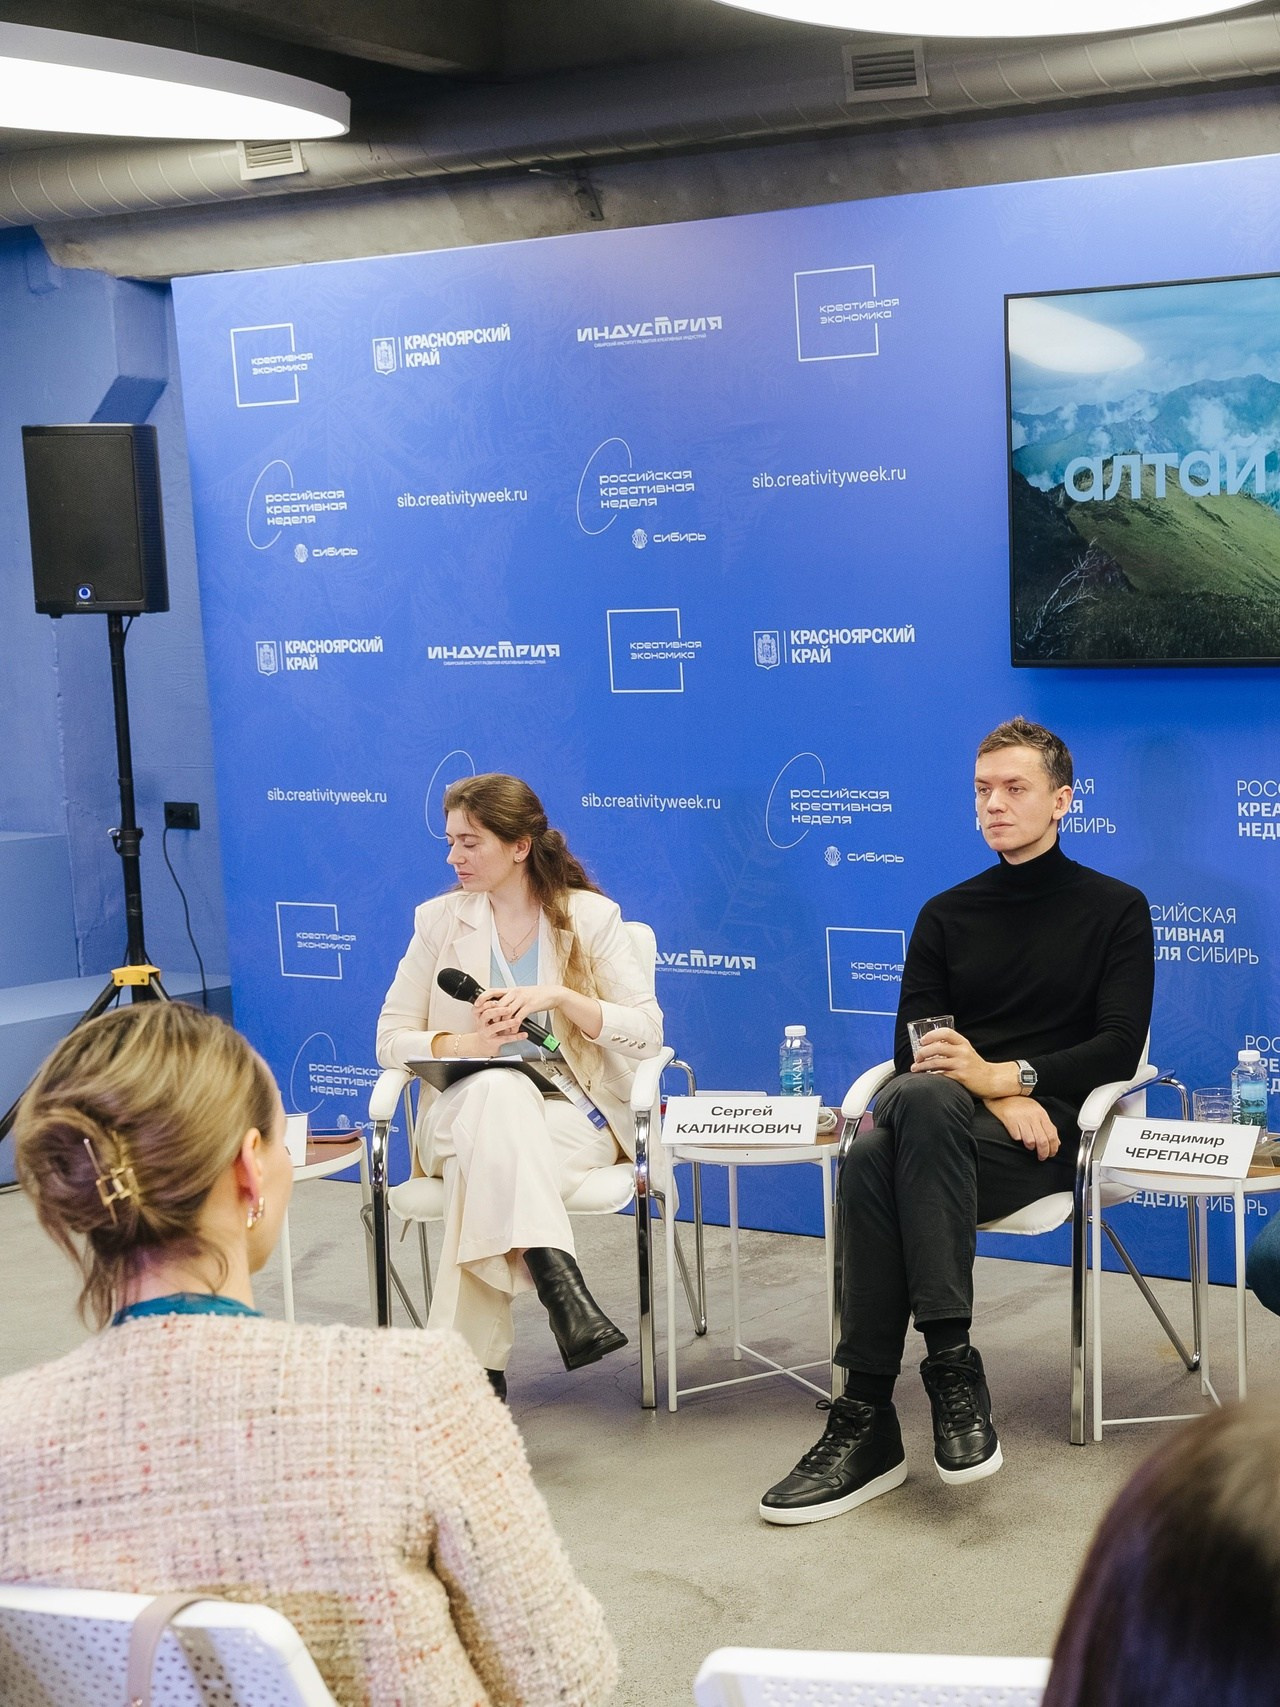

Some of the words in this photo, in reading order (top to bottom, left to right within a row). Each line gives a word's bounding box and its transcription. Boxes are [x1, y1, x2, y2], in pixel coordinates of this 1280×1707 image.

[819, 298, 899, 314] креативная
[820, 309, 892, 325] экономика
[404, 323, 511, 350] КРАСНОЯРСКИЙ
[576, 315, 723, 342] ИНДУСТРИЯ
[251, 352, 313, 365] креативная
[405, 349, 441, 368] КРАЙ
[251, 362, 308, 376] экономика
[1064, 434, 1267, 502] алтай
[599, 470, 692, 485] российская
[752, 465, 907, 490] sib.creativityweek.ru
[265, 489, 345, 503] российская
[600, 482, 695, 498] креативная
[397, 487, 528, 510] sib.creativityweek.ru
[600, 496, 658, 510] неделя
[266, 501, 347, 516] креативная
[267, 513, 316, 527] неделя
[652, 530, 707, 544] сибирь
[312, 546, 358, 559] сибирь
[790, 624, 915, 645] КРАСНОЯРСКИЙ
[284, 635, 383, 655] КРАСНОЯРСКИЙ
[427, 640, 561, 659] ИНДУСТРИЯ
[629, 640, 702, 651] креативная
[286, 653, 319, 671] КРАЙ
[630, 650, 696, 661] экономика
[791, 645, 832, 664] КРАЙ
[267, 787, 387, 806] sib.creativityweek.ru
[790, 786, 890, 800] российская
[581, 792, 721, 812] sib.creativityweek.ru
[791, 800, 892, 813] креативная
[791, 813, 852, 826] неделя
[1060, 816, 1117, 834] ИБИРЬ
[847, 851, 905, 864] сибирь
[1149, 902, 1237, 924] СИЙСКАЯ
[296, 930, 356, 942] креативная
[1153, 926, 1225, 943] ТИВНАЯ
[297, 940, 351, 952] экономика
[655, 949, 756, 970] ДУСТРИЯ
[1186, 945, 1260, 965] СИБИРЬ
[851, 961, 905, 972] креатив
[851, 972, 903, 982] эконом
[310, 1085, 358, 1097] неделя
[710, 1104, 773, 1119] Сергей
[675, 1122, 802, 1135] КАЛИНКОВИЧ
[1139, 1128, 1226, 1148] Владимир
[1125, 1146, 1229, 1166] ЧЕРЕПАНОВ
